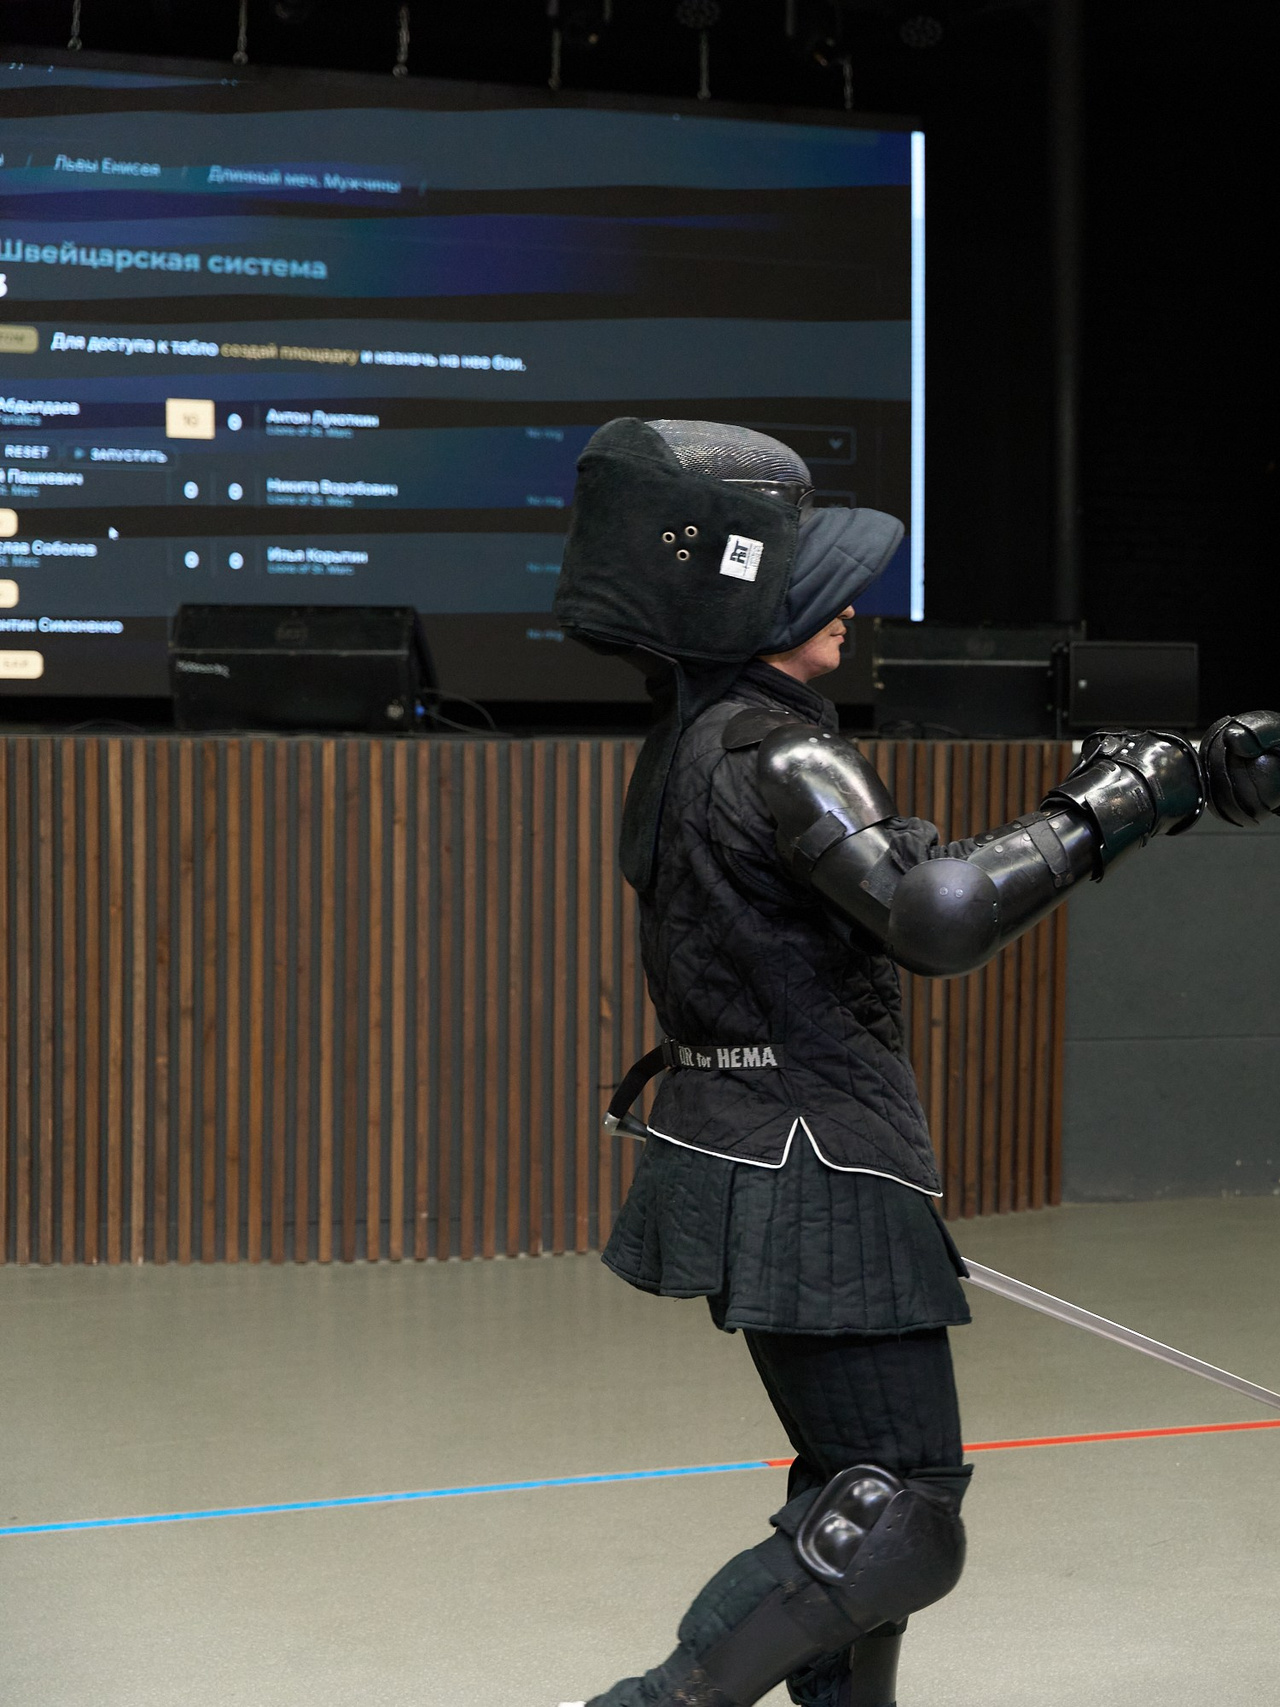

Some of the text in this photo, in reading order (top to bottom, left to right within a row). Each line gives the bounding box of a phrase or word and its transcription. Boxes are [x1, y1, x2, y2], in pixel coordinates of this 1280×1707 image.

[0, 238, 328, 280] Швейцарская система
[51, 331, 86, 352] Для
[87, 336, 156, 356] доступа
[157, 339, 170, 354] к
[171, 338, 219, 357] табло
[4, 444, 50, 460] RESET
[716, 1046, 778, 1068] HEMA
